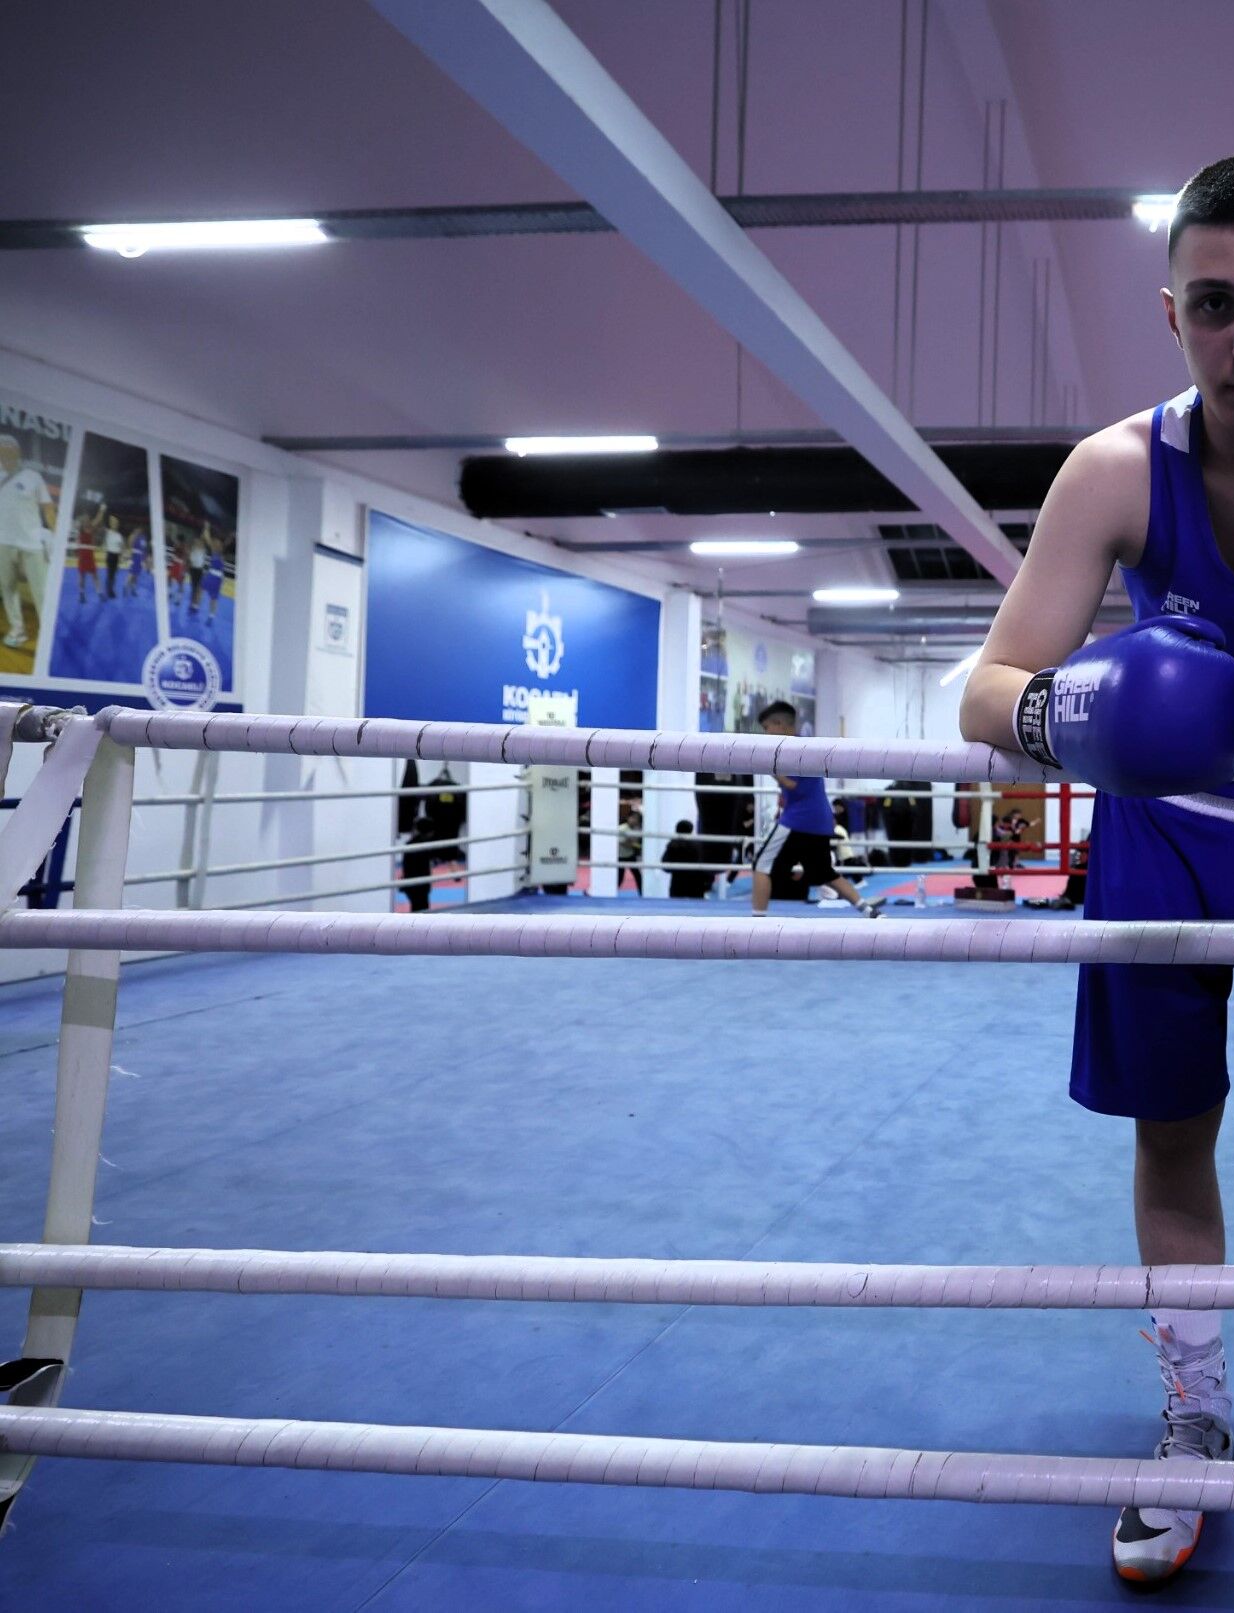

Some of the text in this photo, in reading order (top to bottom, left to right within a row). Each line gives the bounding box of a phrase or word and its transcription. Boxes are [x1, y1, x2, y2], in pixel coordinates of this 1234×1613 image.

[1167, 591, 1200, 610] REEN
[1054, 672, 1101, 695] GREEN
[1054, 693, 1089, 723] HILL
